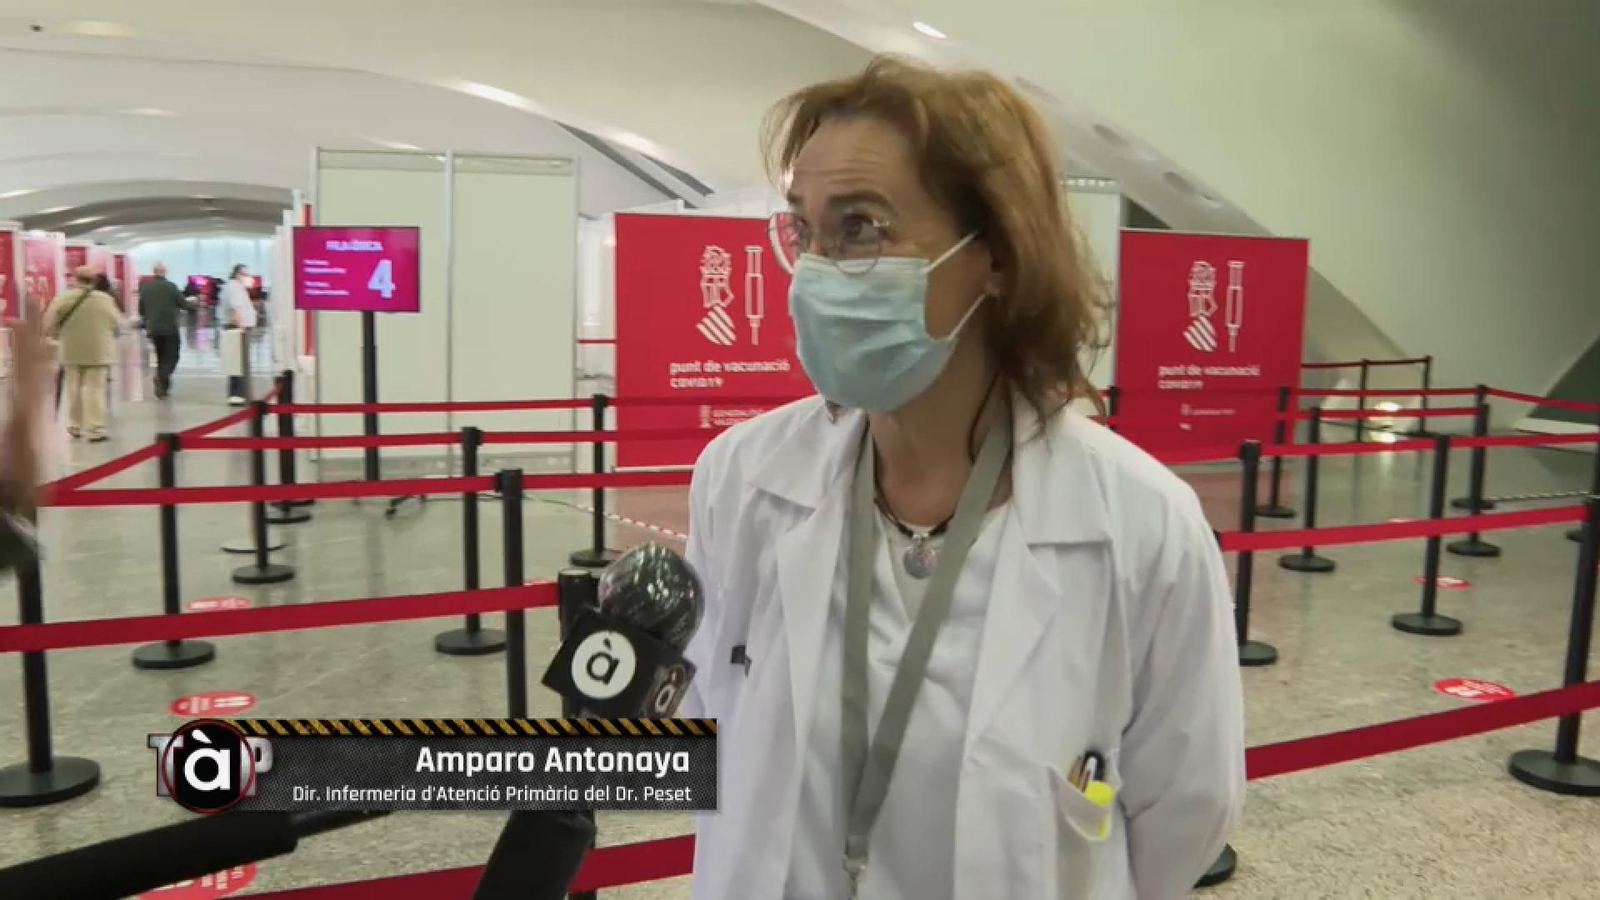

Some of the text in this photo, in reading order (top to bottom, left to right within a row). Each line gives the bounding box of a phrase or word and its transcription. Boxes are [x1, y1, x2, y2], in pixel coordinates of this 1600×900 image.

[367, 259, 396, 299] 4
[669, 358, 791, 375] punt de vacunació
